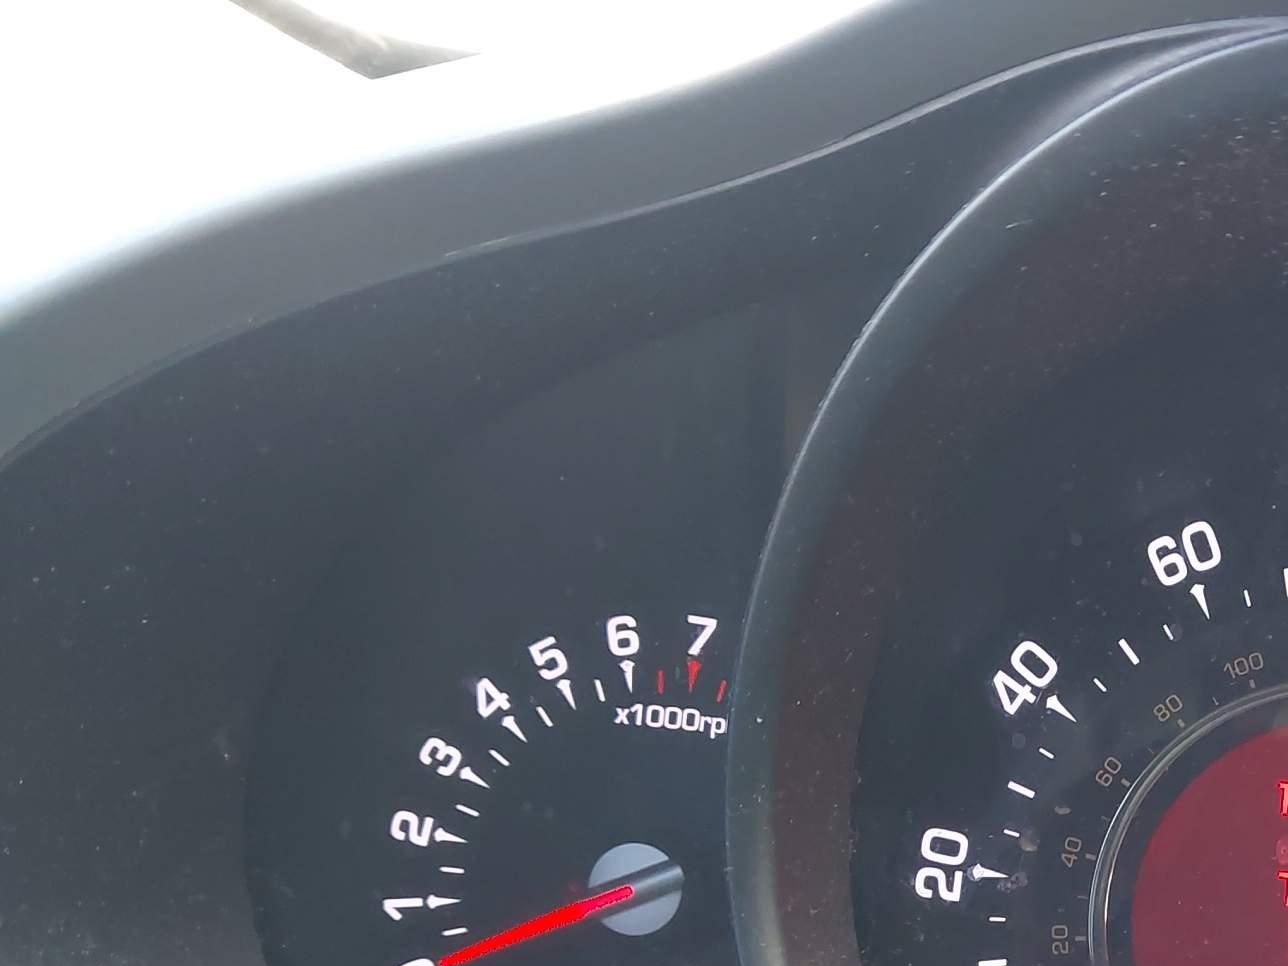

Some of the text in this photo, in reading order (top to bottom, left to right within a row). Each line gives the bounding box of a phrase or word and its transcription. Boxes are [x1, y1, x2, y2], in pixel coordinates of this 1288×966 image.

[1146, 521, 1222, 586] 60
[606, 615, 640, 656] 6
[687, 615, 717, 656] 7
[528, 636, 568, 681] 5
[992, 641, 1058, 715] 40
[1223, 652, 1265, 679] 100
[476, 677, 512, 719] 4
[1153, 695, 1183, 722] 80
[419, 737, 463, 776] 3
[1095, 757, 1123, 789] 60
[390, 811, 434, 846] 2
[915, 828, 969, 902] 20
[1060, 836, 1083, 867] 40
[382, 897, 424, 920] 1
[1050, 924, 1070, 955] 20
